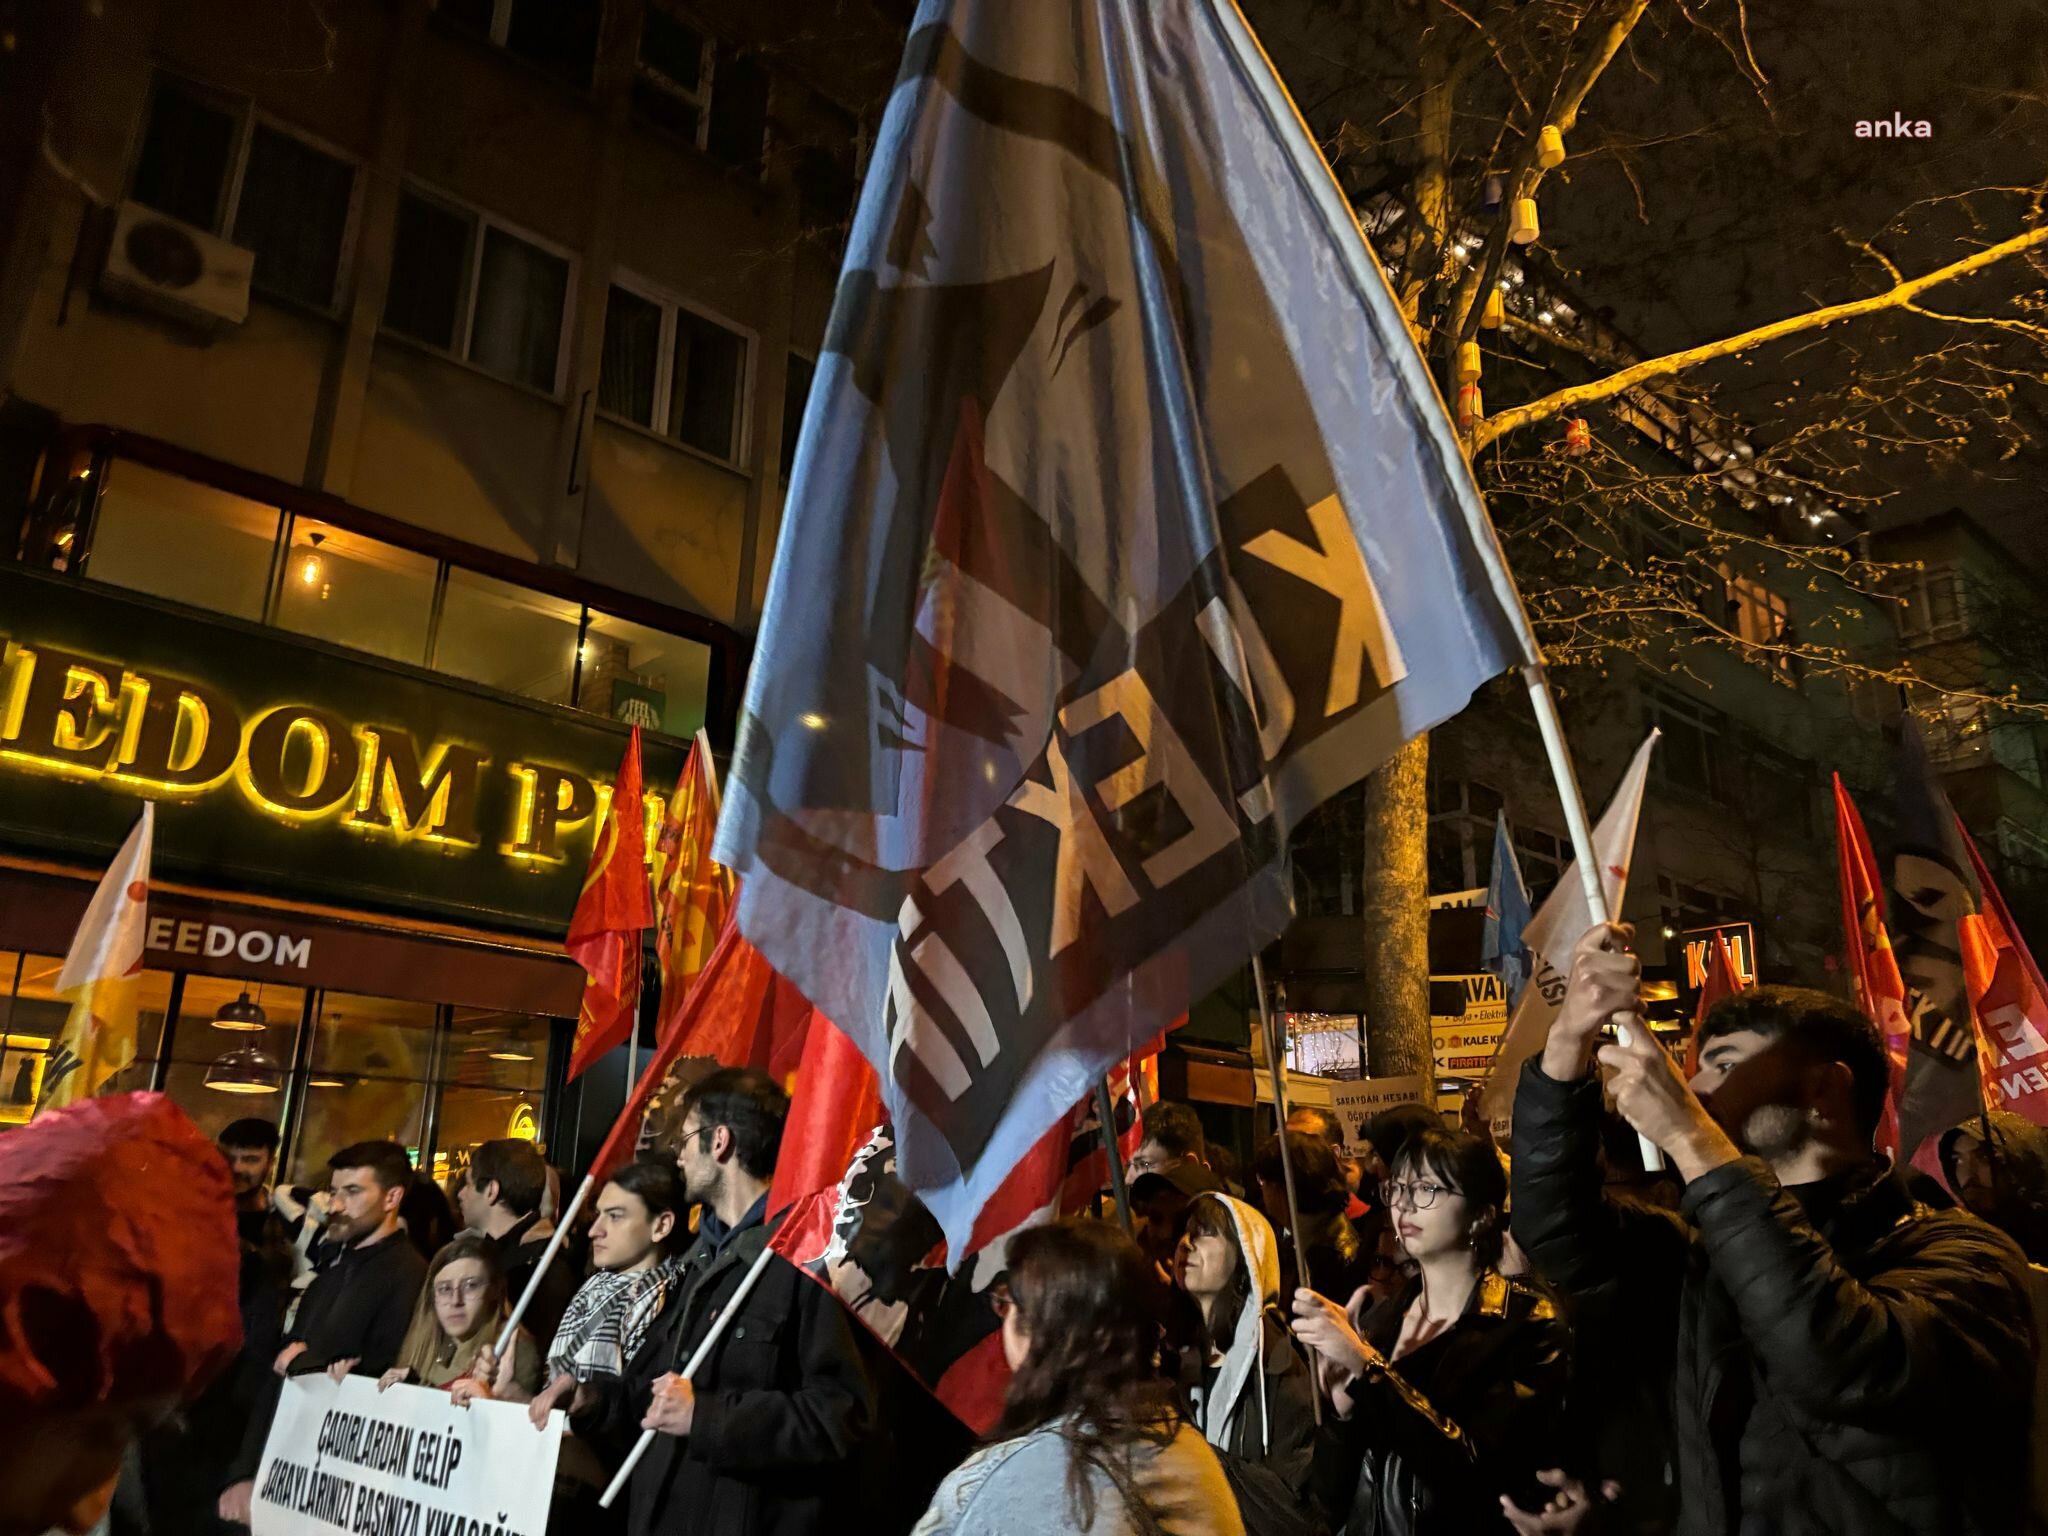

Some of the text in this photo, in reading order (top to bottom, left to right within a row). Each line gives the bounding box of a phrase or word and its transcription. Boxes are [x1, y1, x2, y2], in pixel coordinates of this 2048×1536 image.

[1686, 935, 1752, 989] KL
[1463, 1036, 1489, 1046] KALE
[315, 1409, 462, 1491] ÇADIRLARDAN GELİP
